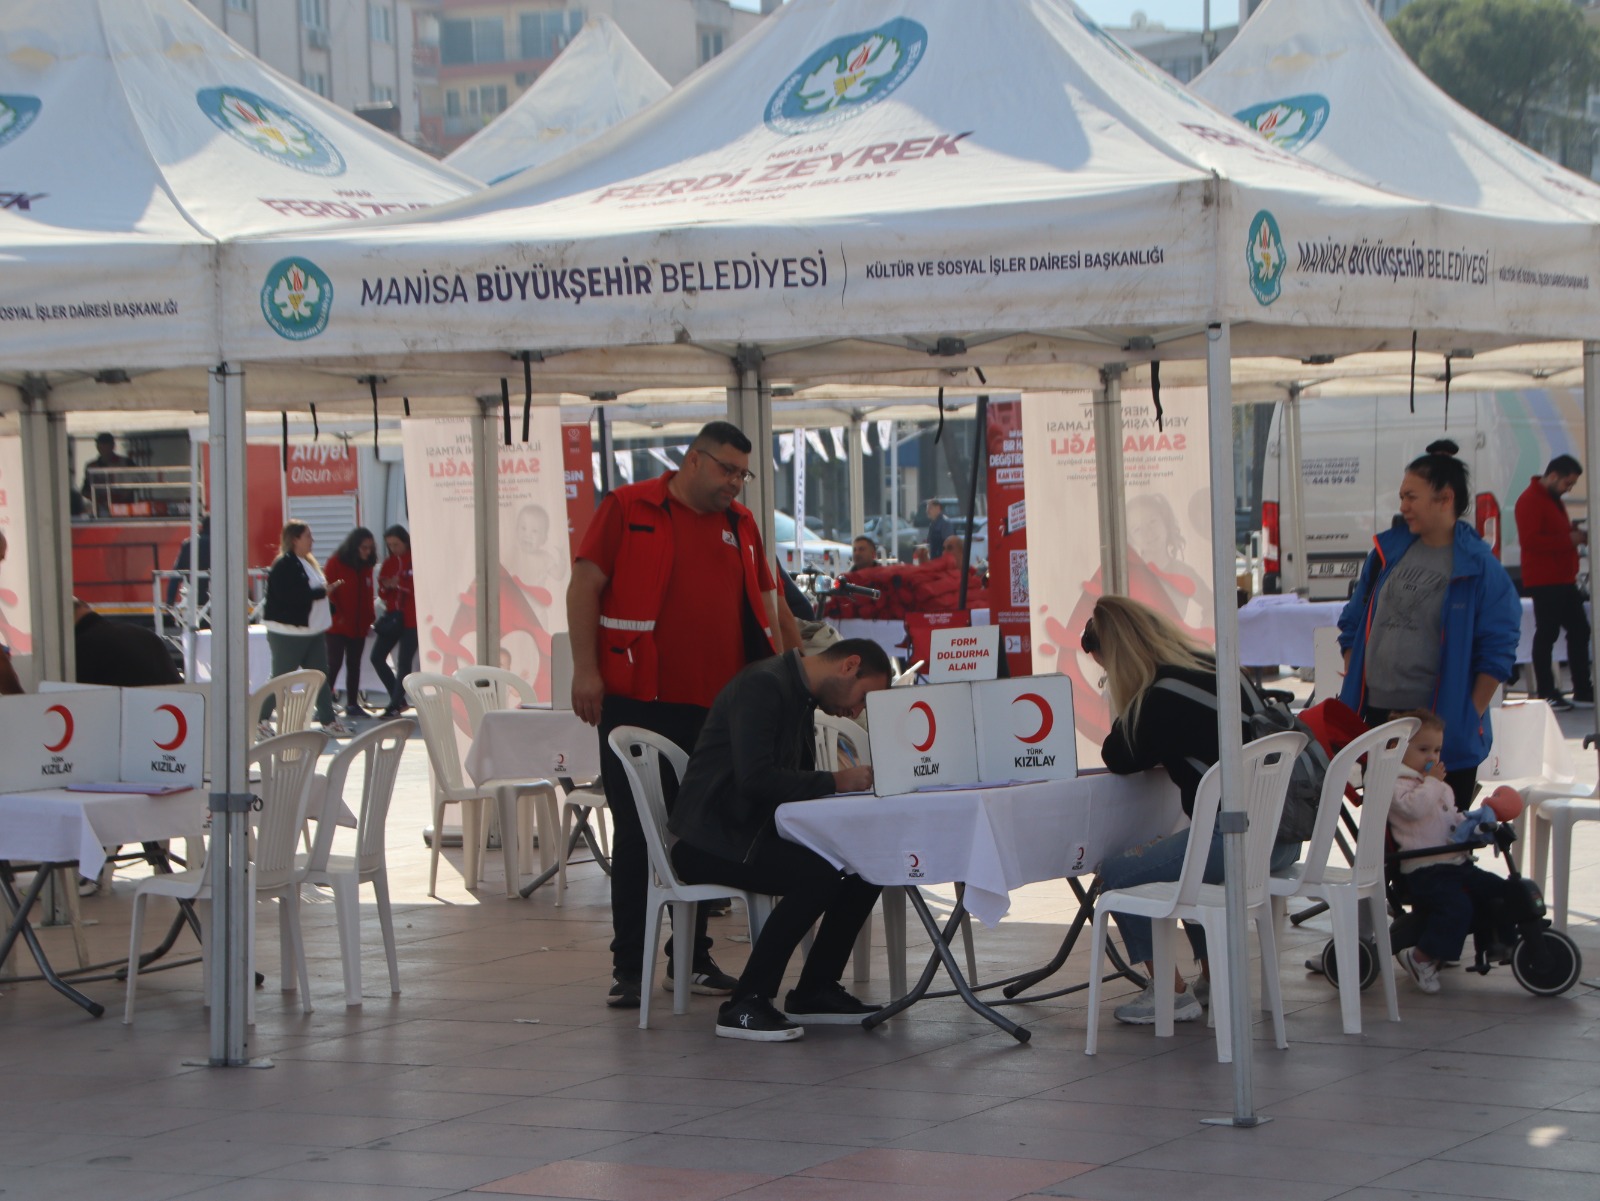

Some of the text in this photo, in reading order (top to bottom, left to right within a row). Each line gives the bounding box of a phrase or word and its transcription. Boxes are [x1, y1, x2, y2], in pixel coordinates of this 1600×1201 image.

[590, 130, 975, 205] FERDİ ZEYREK
[866, 246, 1165, 279] KÜLTÜR VE SOSYAL İŞLER DAİRESİ BAŞKANLIĞI
[1297, 236, 1348, 274] MANİSA
[1348, 238, 1426, 283] BÜYÜKŞEHİR
[1427, 246, 1489, 286] BELEDİYESİ
[361, 249, 827, 306] MANİSA BÜYÜKŞEHİR BELEDİYESİ
[0, 298, 179, 323] OSYAL İŞLER DAİRESİ BAŞKANLIĞI
[951, 637, 978, 647] FORM
[937, 649, 990, 661] DOLDURMA
[948, 662, 977, 672] ALANI
[162, 754, 176, 762] TÜRK
[1014, 755, 1056, 768] KIZILAY
[41, 762, 74, 775] KIZILAY
[151, 761, 187, 774] KIZILAY
[913, 763, 940, 777] KIZILAY
